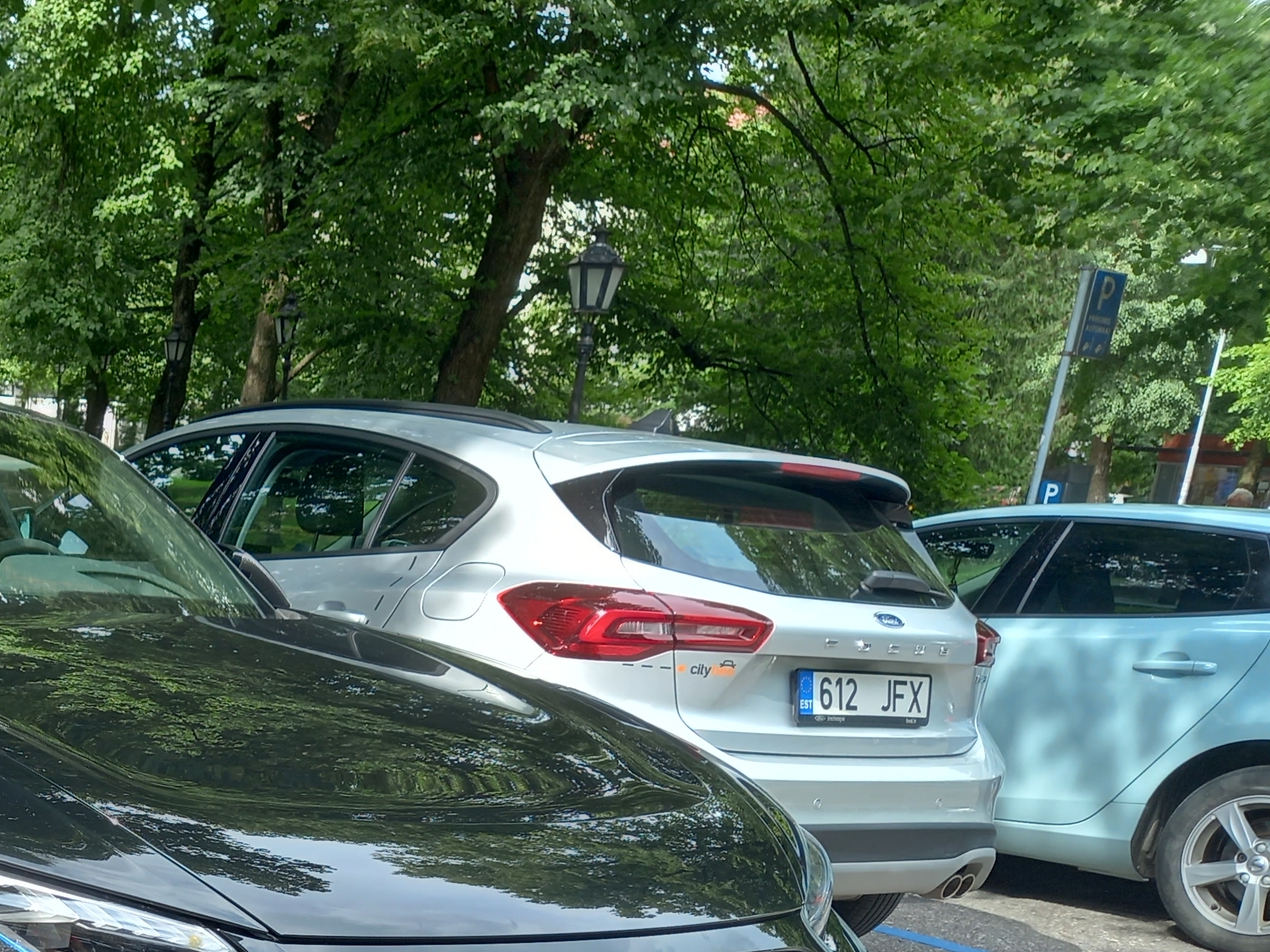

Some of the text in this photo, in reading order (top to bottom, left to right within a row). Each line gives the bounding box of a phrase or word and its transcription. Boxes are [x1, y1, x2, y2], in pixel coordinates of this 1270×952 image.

[1097, 275, 1116, 310] P
[1043, 483, 1059, 504] P
[800, 699, 813, 709] EST
[819, 676, 923, 713] 612 JFX
